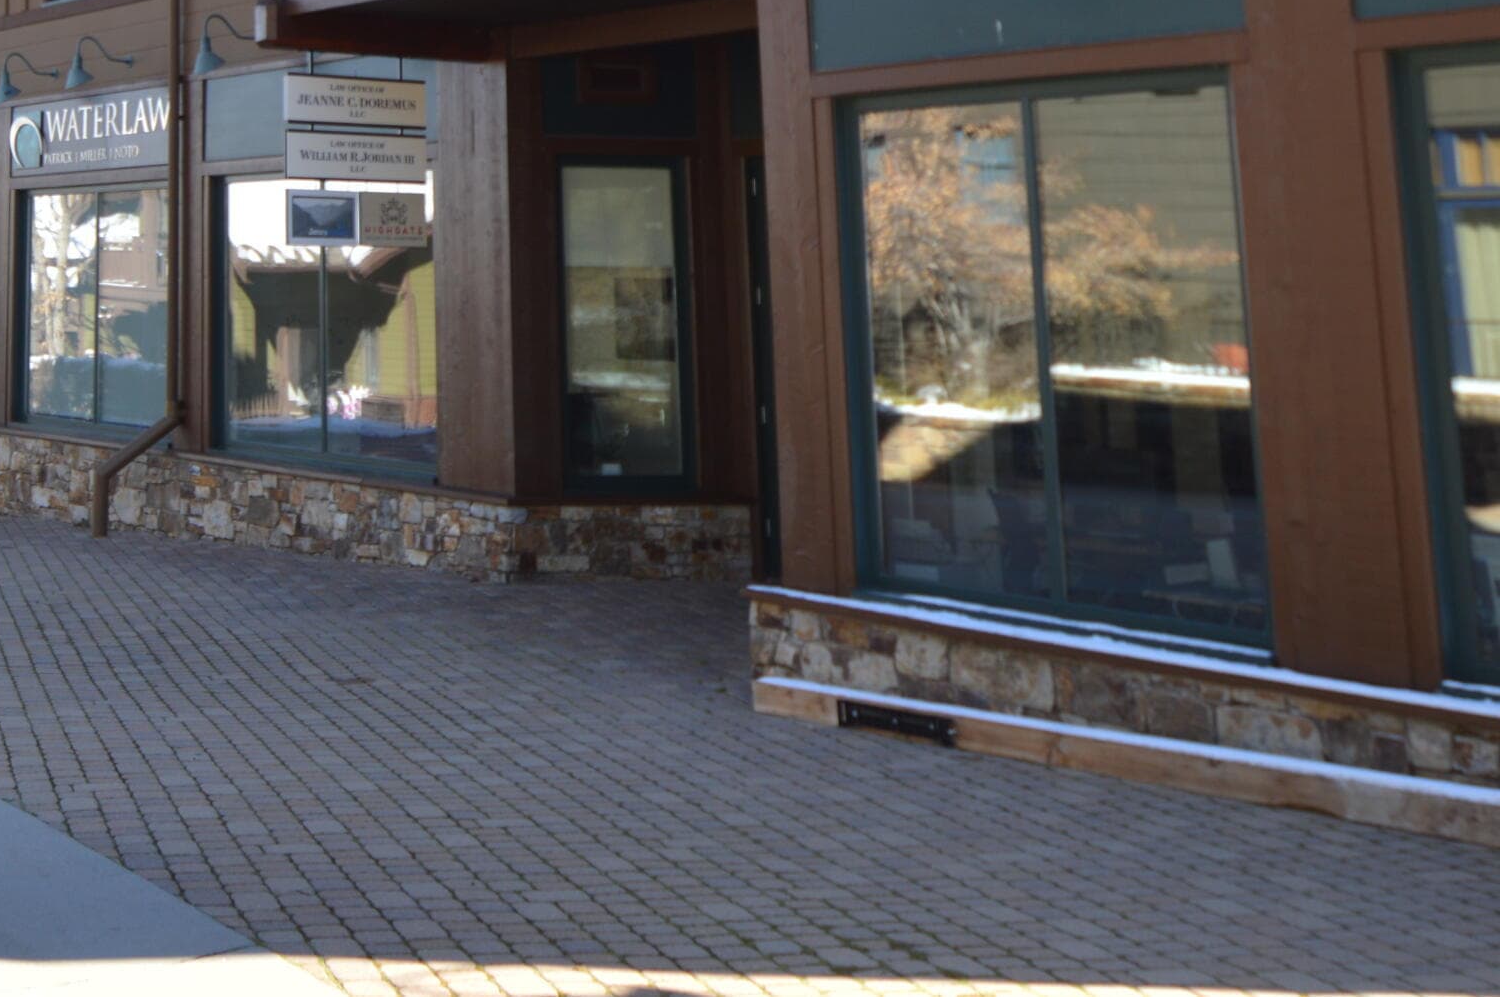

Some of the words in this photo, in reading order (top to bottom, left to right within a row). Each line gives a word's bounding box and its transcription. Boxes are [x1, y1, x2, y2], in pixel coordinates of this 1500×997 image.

[298, 94, 345, 108] JEANNE
[348, 97, 358, 108] C.
[359, 98, 417, 110] DOREMUS
[46, 96, 170, 143] WATERLAW
[330, 140, 345, 148] LAW
[348, 141, 374, 149] OFFICE
[44, 151, 73, 164] PATRICK
[80, 148, 107, 163] MILLER
[114, 145, 139, 160] NOTO
[300, 149, 348, 162] WILLIAM
[360, 152, 402, 164] JORDAN
[404, 154, 415, 164] III
